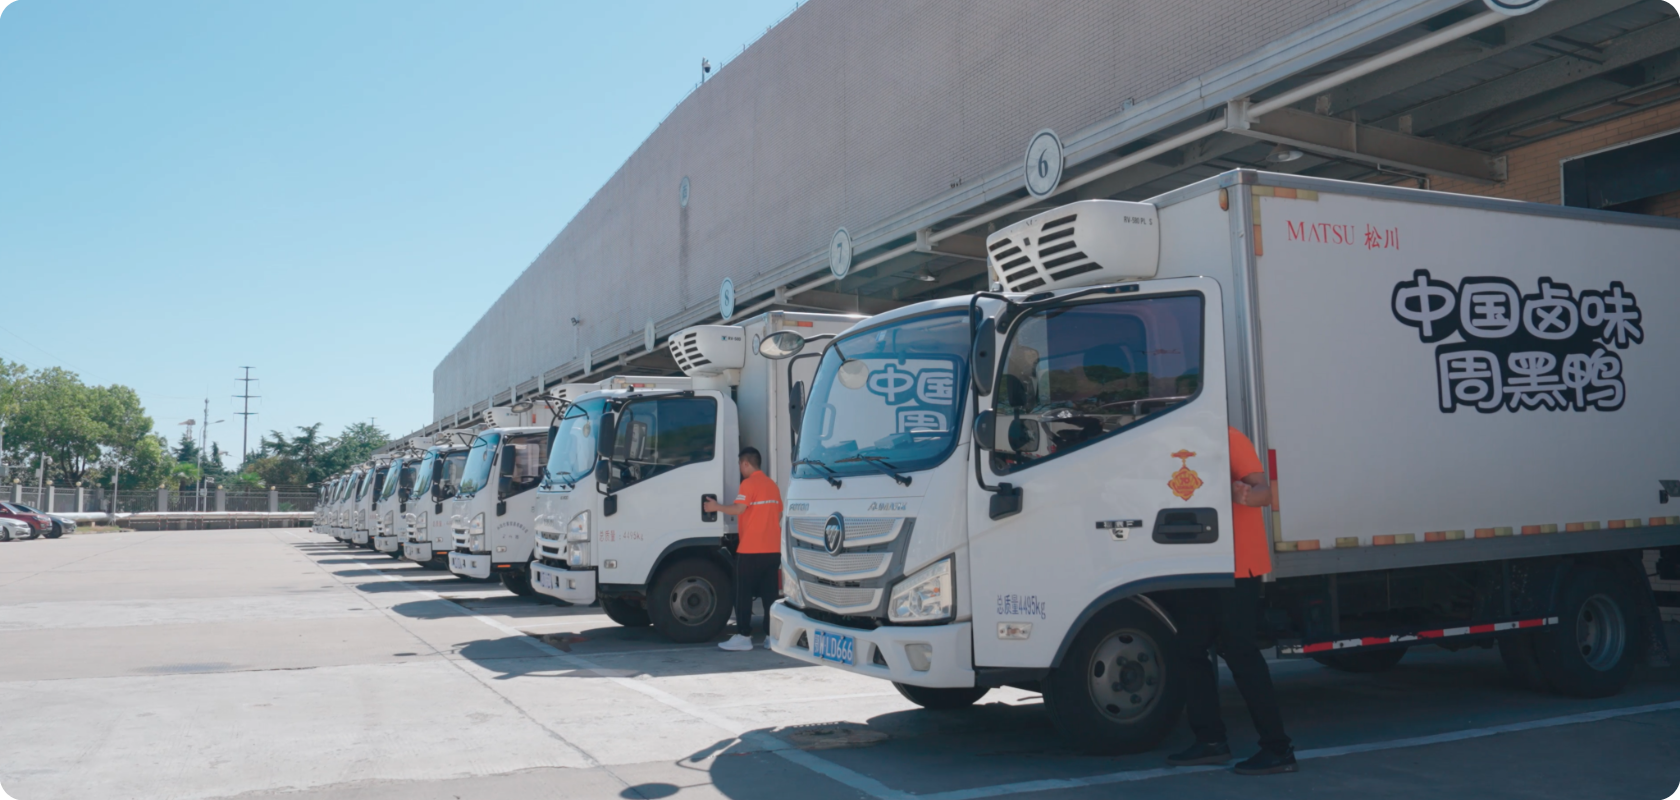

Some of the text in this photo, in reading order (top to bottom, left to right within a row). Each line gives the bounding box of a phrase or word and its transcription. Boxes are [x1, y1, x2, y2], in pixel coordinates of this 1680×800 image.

[1038, 148, 1049, 179] 6
[1286, 220, 1400, 251] MATSU 松川
[836, 242, 843, 264] 7
[724, 289, 730, 307] 8
[1393, 271, 1643, 347] 中国卤味
[1437, 347, 1626, 411] 周黑鸭
[996, 594, 1046, 620] 总质量4495kg
